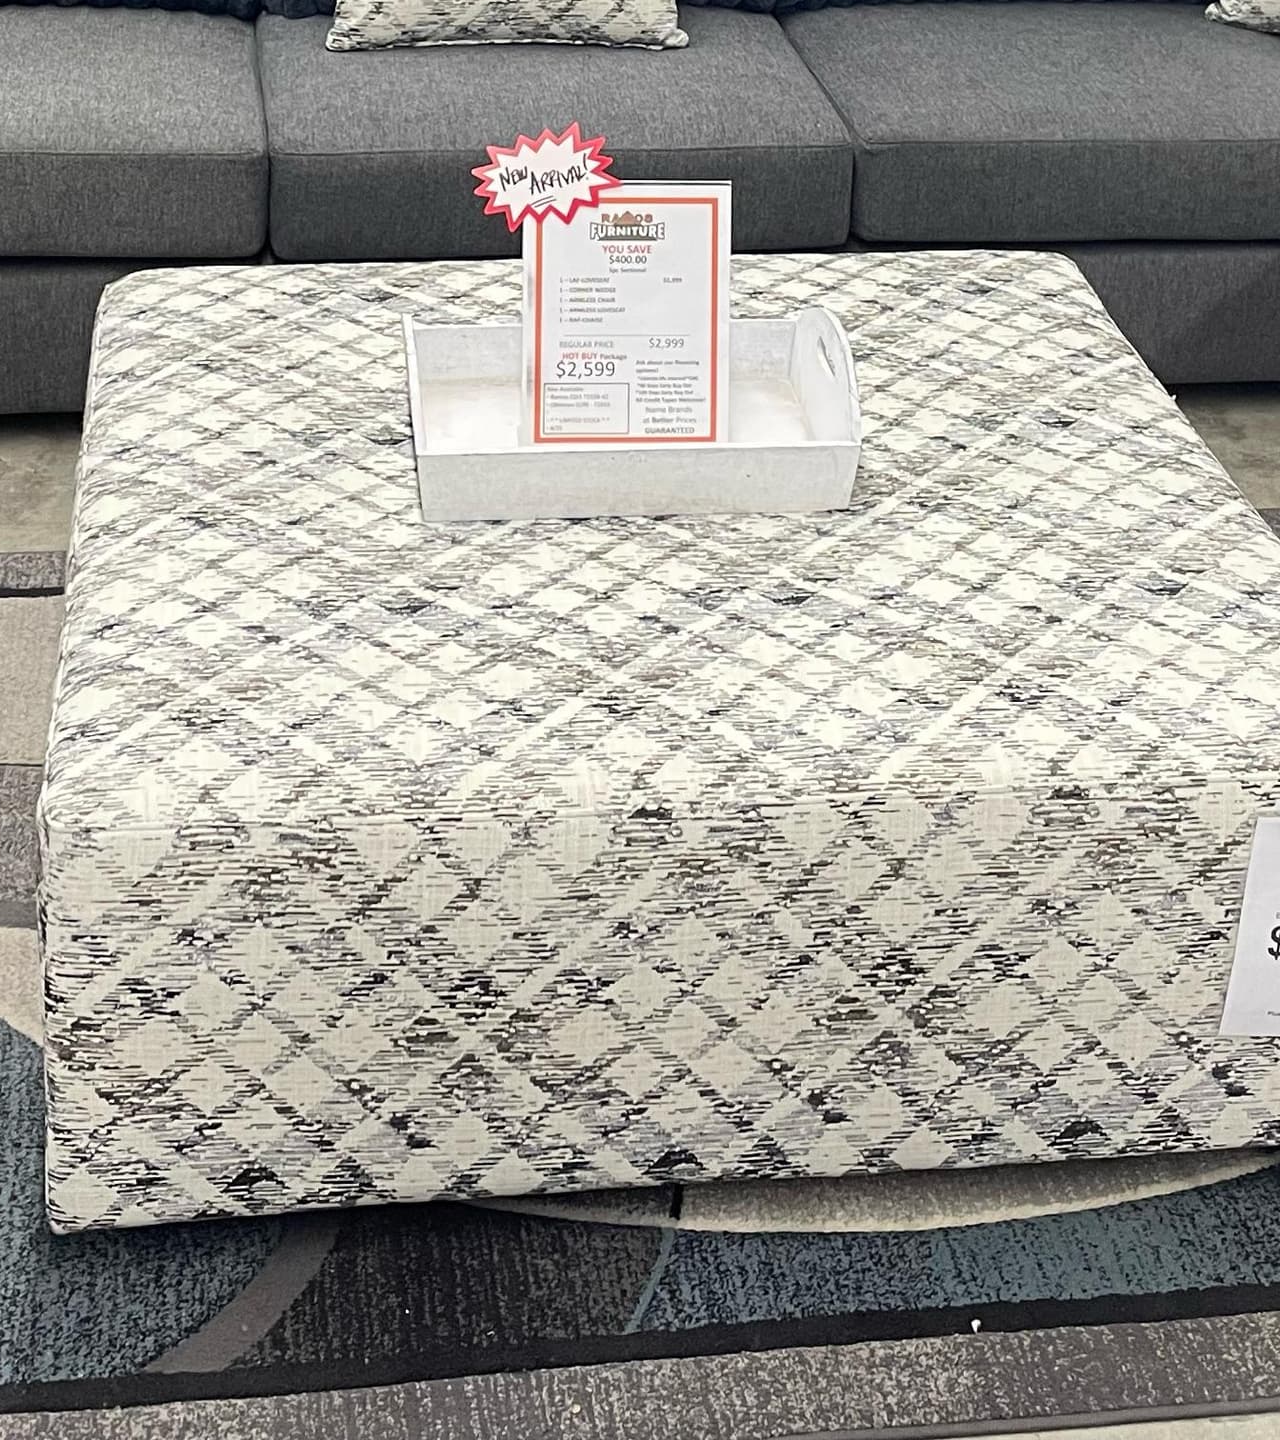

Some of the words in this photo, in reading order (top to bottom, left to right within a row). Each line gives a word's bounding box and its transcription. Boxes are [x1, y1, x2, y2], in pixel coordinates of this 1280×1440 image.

[499, 166, 528, 192] NEW
[529, 153, 589, 195] ARRIVAL!
[590, 222, 665, 241] FURNITURE
[602, 245, 624, 254] YOU
[626, 245, 652, 254] SAVE
[609, 255, 647, 264] $400.00
[594, 341, 614, 349] PRICE
[648, 337, 684, 350] $2,999
[562, 352, 579, 360] HOT
[581, 352, 598, 360] BUY
[556, 360, 616, 379] $2,599
